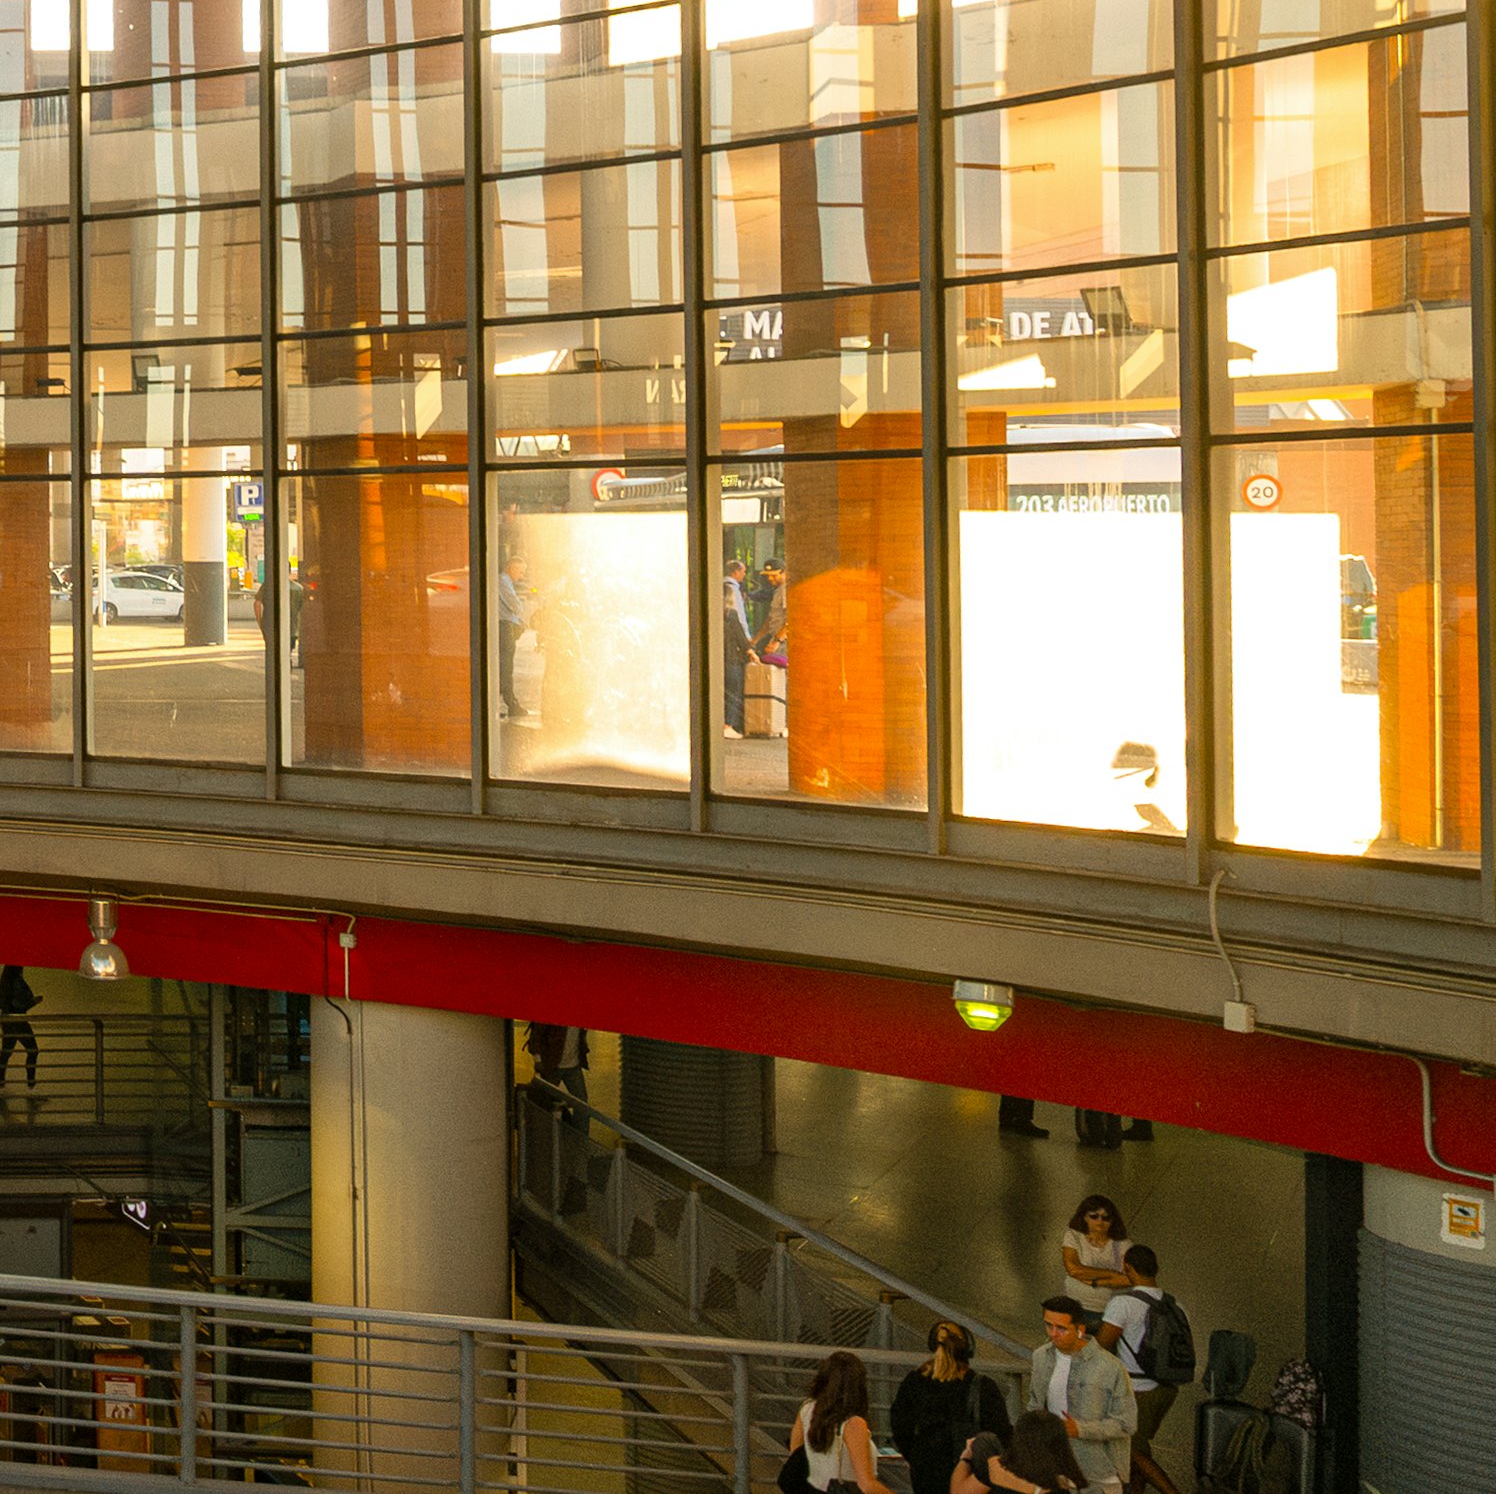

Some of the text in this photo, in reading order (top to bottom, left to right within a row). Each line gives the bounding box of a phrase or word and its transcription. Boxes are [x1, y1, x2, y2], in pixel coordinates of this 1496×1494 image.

[1009, 311, 1052, 340] DE
[1250, 486, 1274, 499] 20
[1016, 493, 1171, 513] 203 AEROPUERTO
